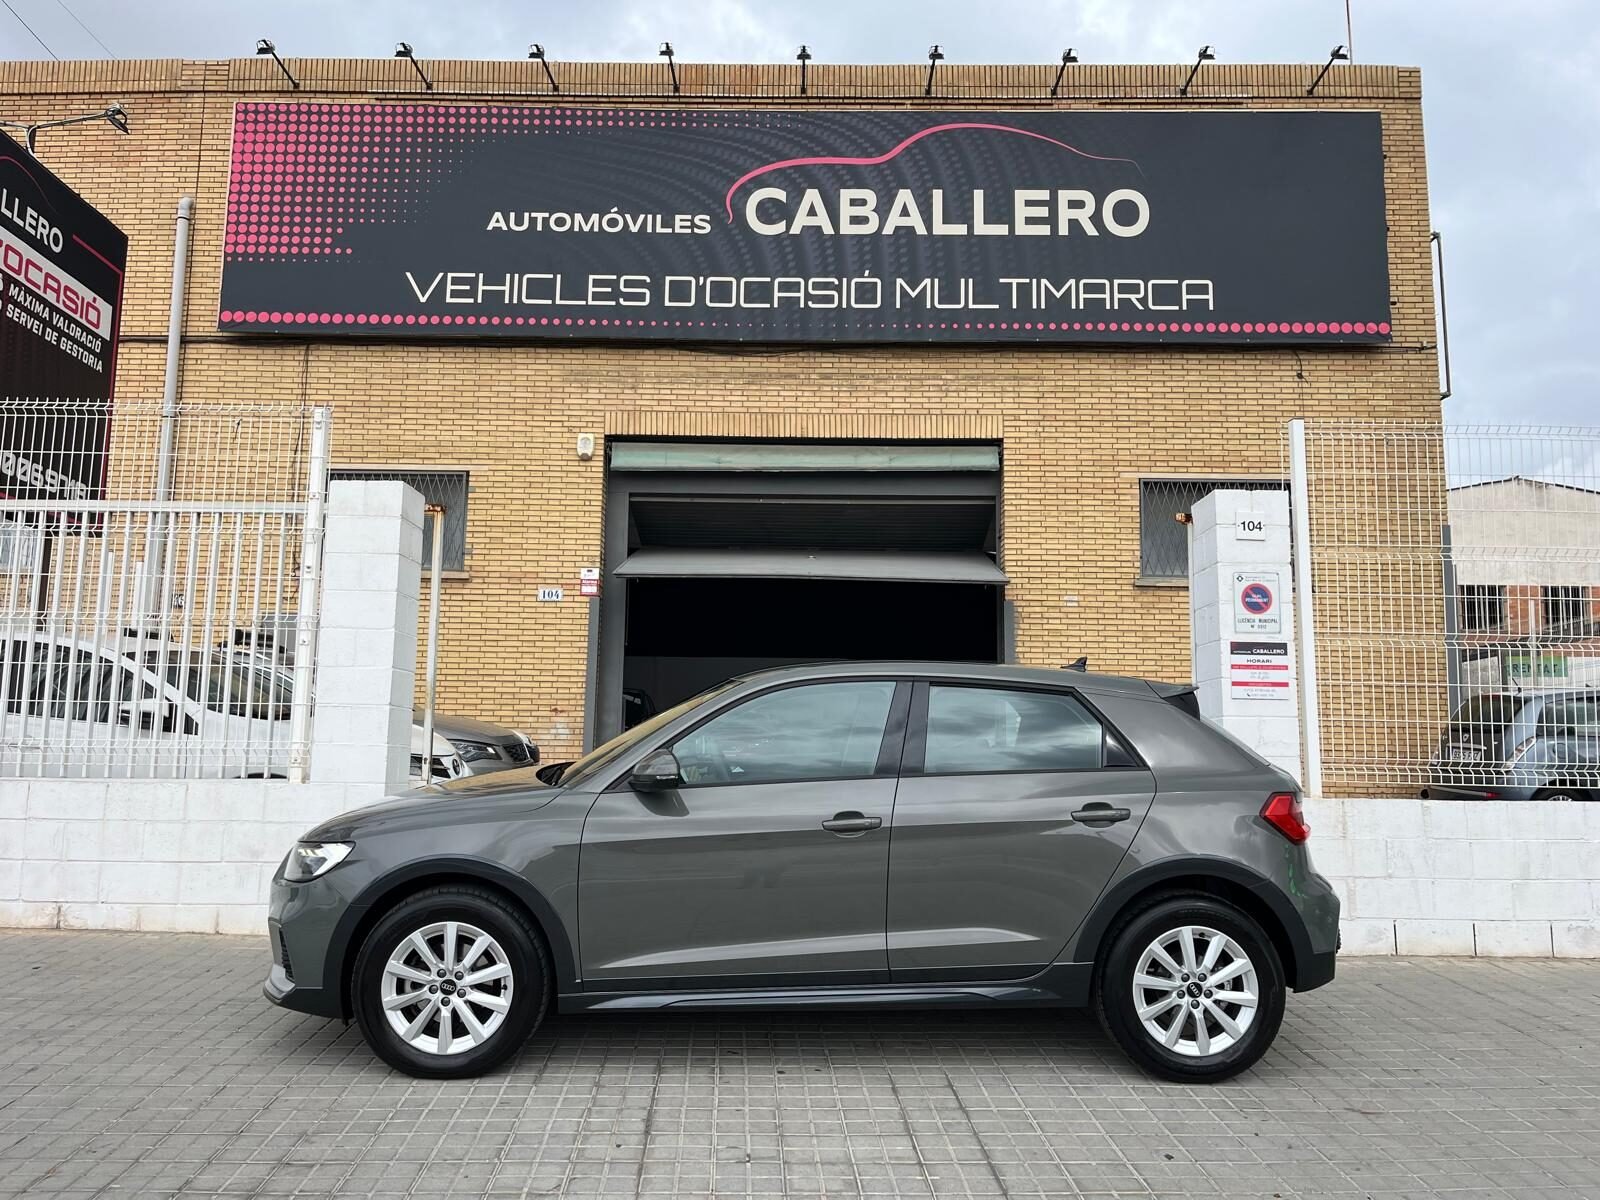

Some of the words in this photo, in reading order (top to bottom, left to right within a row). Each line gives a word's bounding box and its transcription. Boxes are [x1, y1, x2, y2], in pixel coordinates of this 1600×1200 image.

[486, 206, 712, 235] AUTOMÓVILES
[745, 187, 1151, 238] CABALLERO
[405, 271, 651, 307] VEHICLES
[664, 269, 882, 309] D'OCASIÓ
[895, 277, 1215, 311] MULTIMARCA
[6, 303, 43, 336] SERVEI
[44, 327, 59, 346] DE
[60, 337, 103, 373] GESTORIA
[52, 311, 102, 353] VALORACIÓ
[1240, 520, 1263, 532] 104
[542, 589, 560, 600] 104
